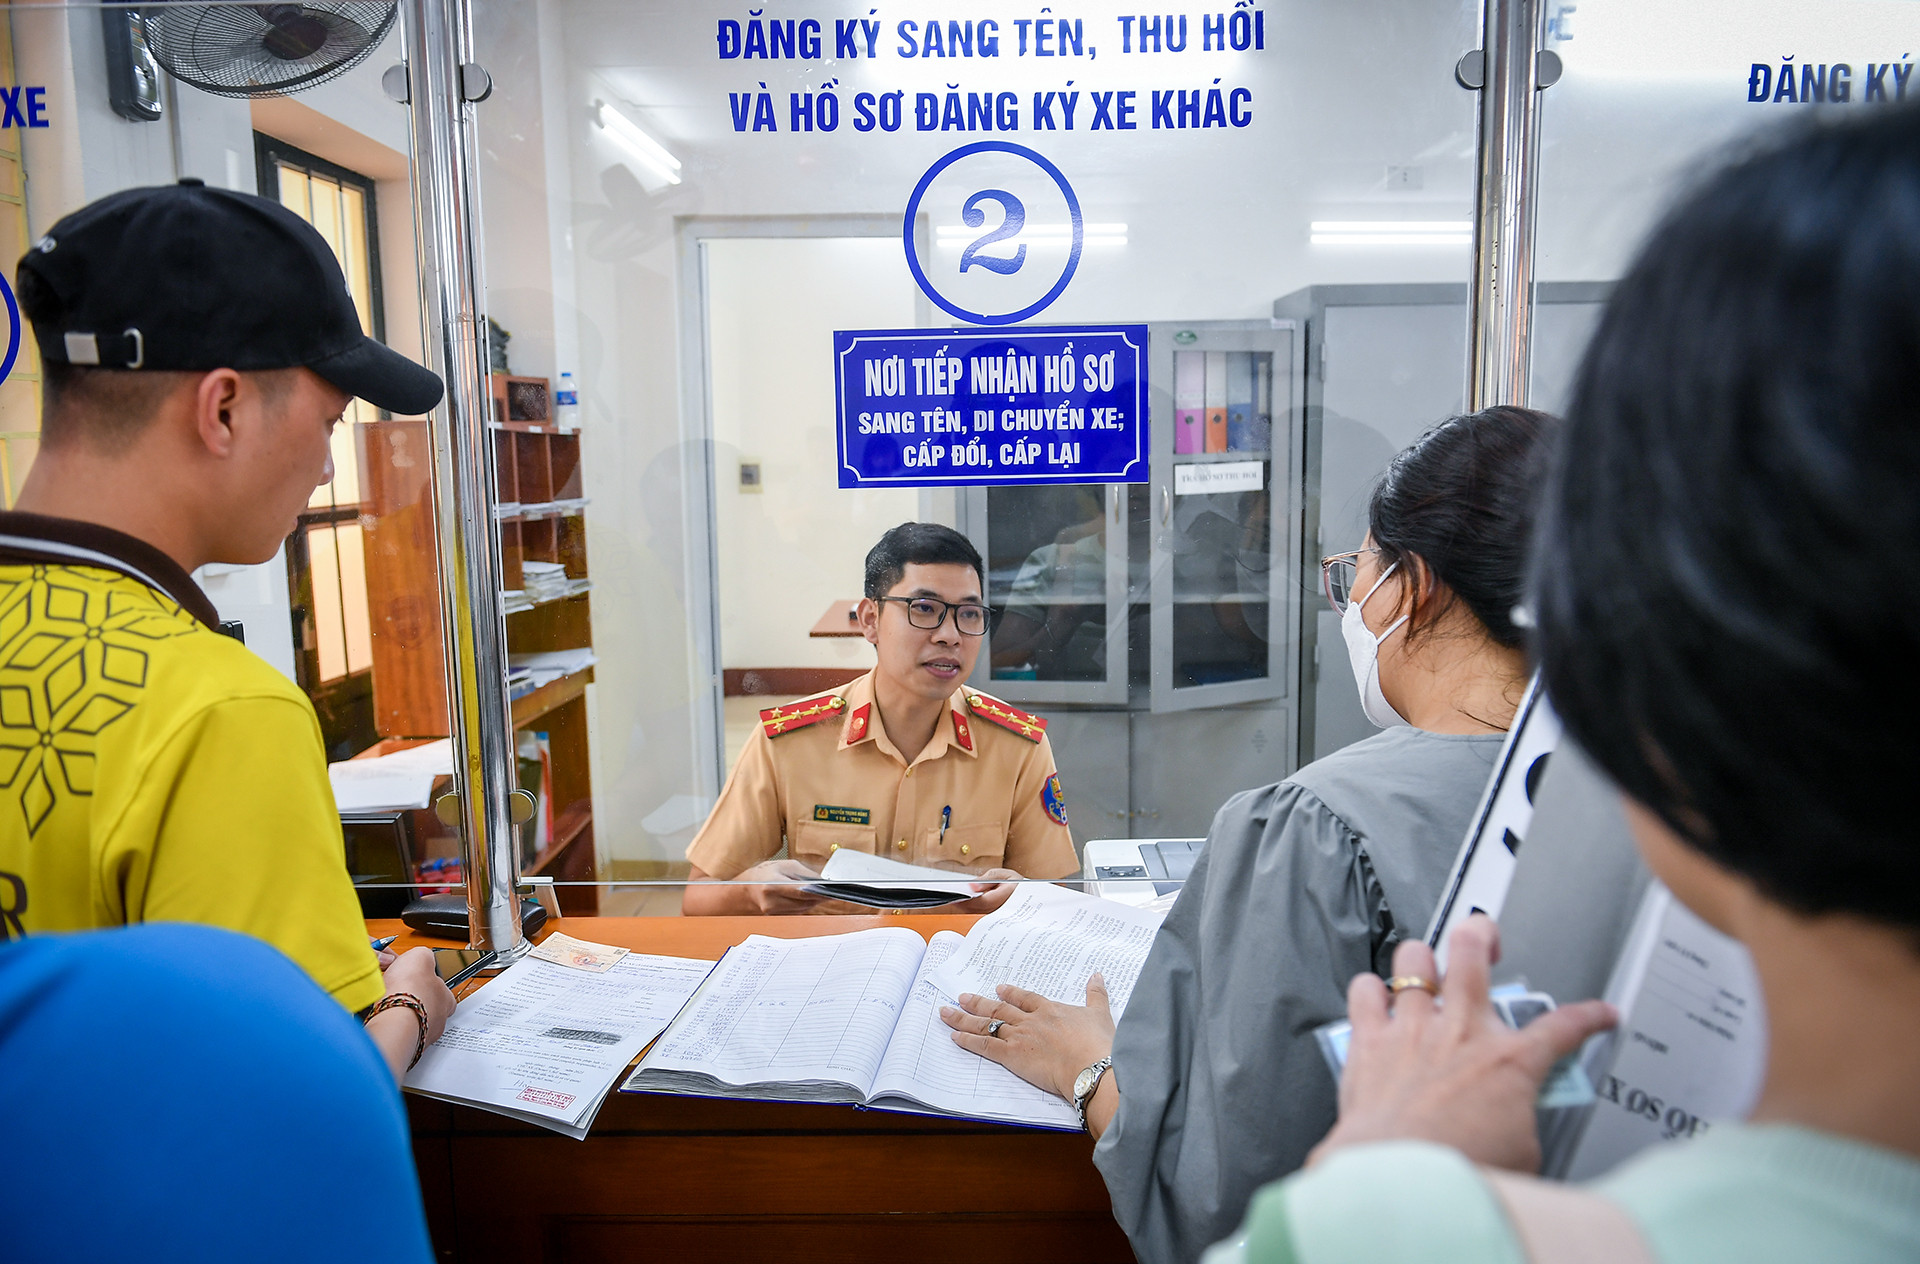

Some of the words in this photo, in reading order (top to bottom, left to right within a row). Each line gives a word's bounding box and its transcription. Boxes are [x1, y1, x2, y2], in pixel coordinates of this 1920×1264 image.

[716, 8, 822, 60] ĐĂNG
[834, 8, 881, 60] KÝ
[897, 19, 999, 59] SANG
[1013, 7, 1096, 61] TÊN,
[1117, 14, 1188, 54] THU
[1202, 0, 1265, 52] HỒI
[1746, 54, 1850, 103] ĐĂNG
[1864, 53, 1915, 102] KÝ
[0, 86, 50, 129] XE
[728, 81, 778, 133] VÀ
[789, 77, 839, 133] HỒ
[852, 89, 904, 133] SƠ
[914, 82, 1019, 132] ĐĂNG
[1033, 80, 1080, 131] KÝ
[1090, 90, 1137, 131] XE
[1151, 77, 1253, 130] KHÁC
[959, 189, 1027, 276] 2
[863, 354, 906, 397] NƠI
[911, 344, 963, 396] TIẾP
[970, 347, 1037, 403] NHẬN
[1044, 341, 1076, 393] HỒ
[1083, 350, 1116, 393] SƠ
[858, 411, 915, 435] SANG
[920, 406, 967, 435] TÊN,
[973, 409, 995, 432] DI
[1001, 399, 1085, 432] CHUYỂN
[1090, 407, 1124, 432] XE;
[903, 437, 945, 468] CẤP
[950, 435, 993, 469] ĐỔI,
[999, 435, 1042, 466] CẤP
[1048, 442, 1081, 469] LẠI
